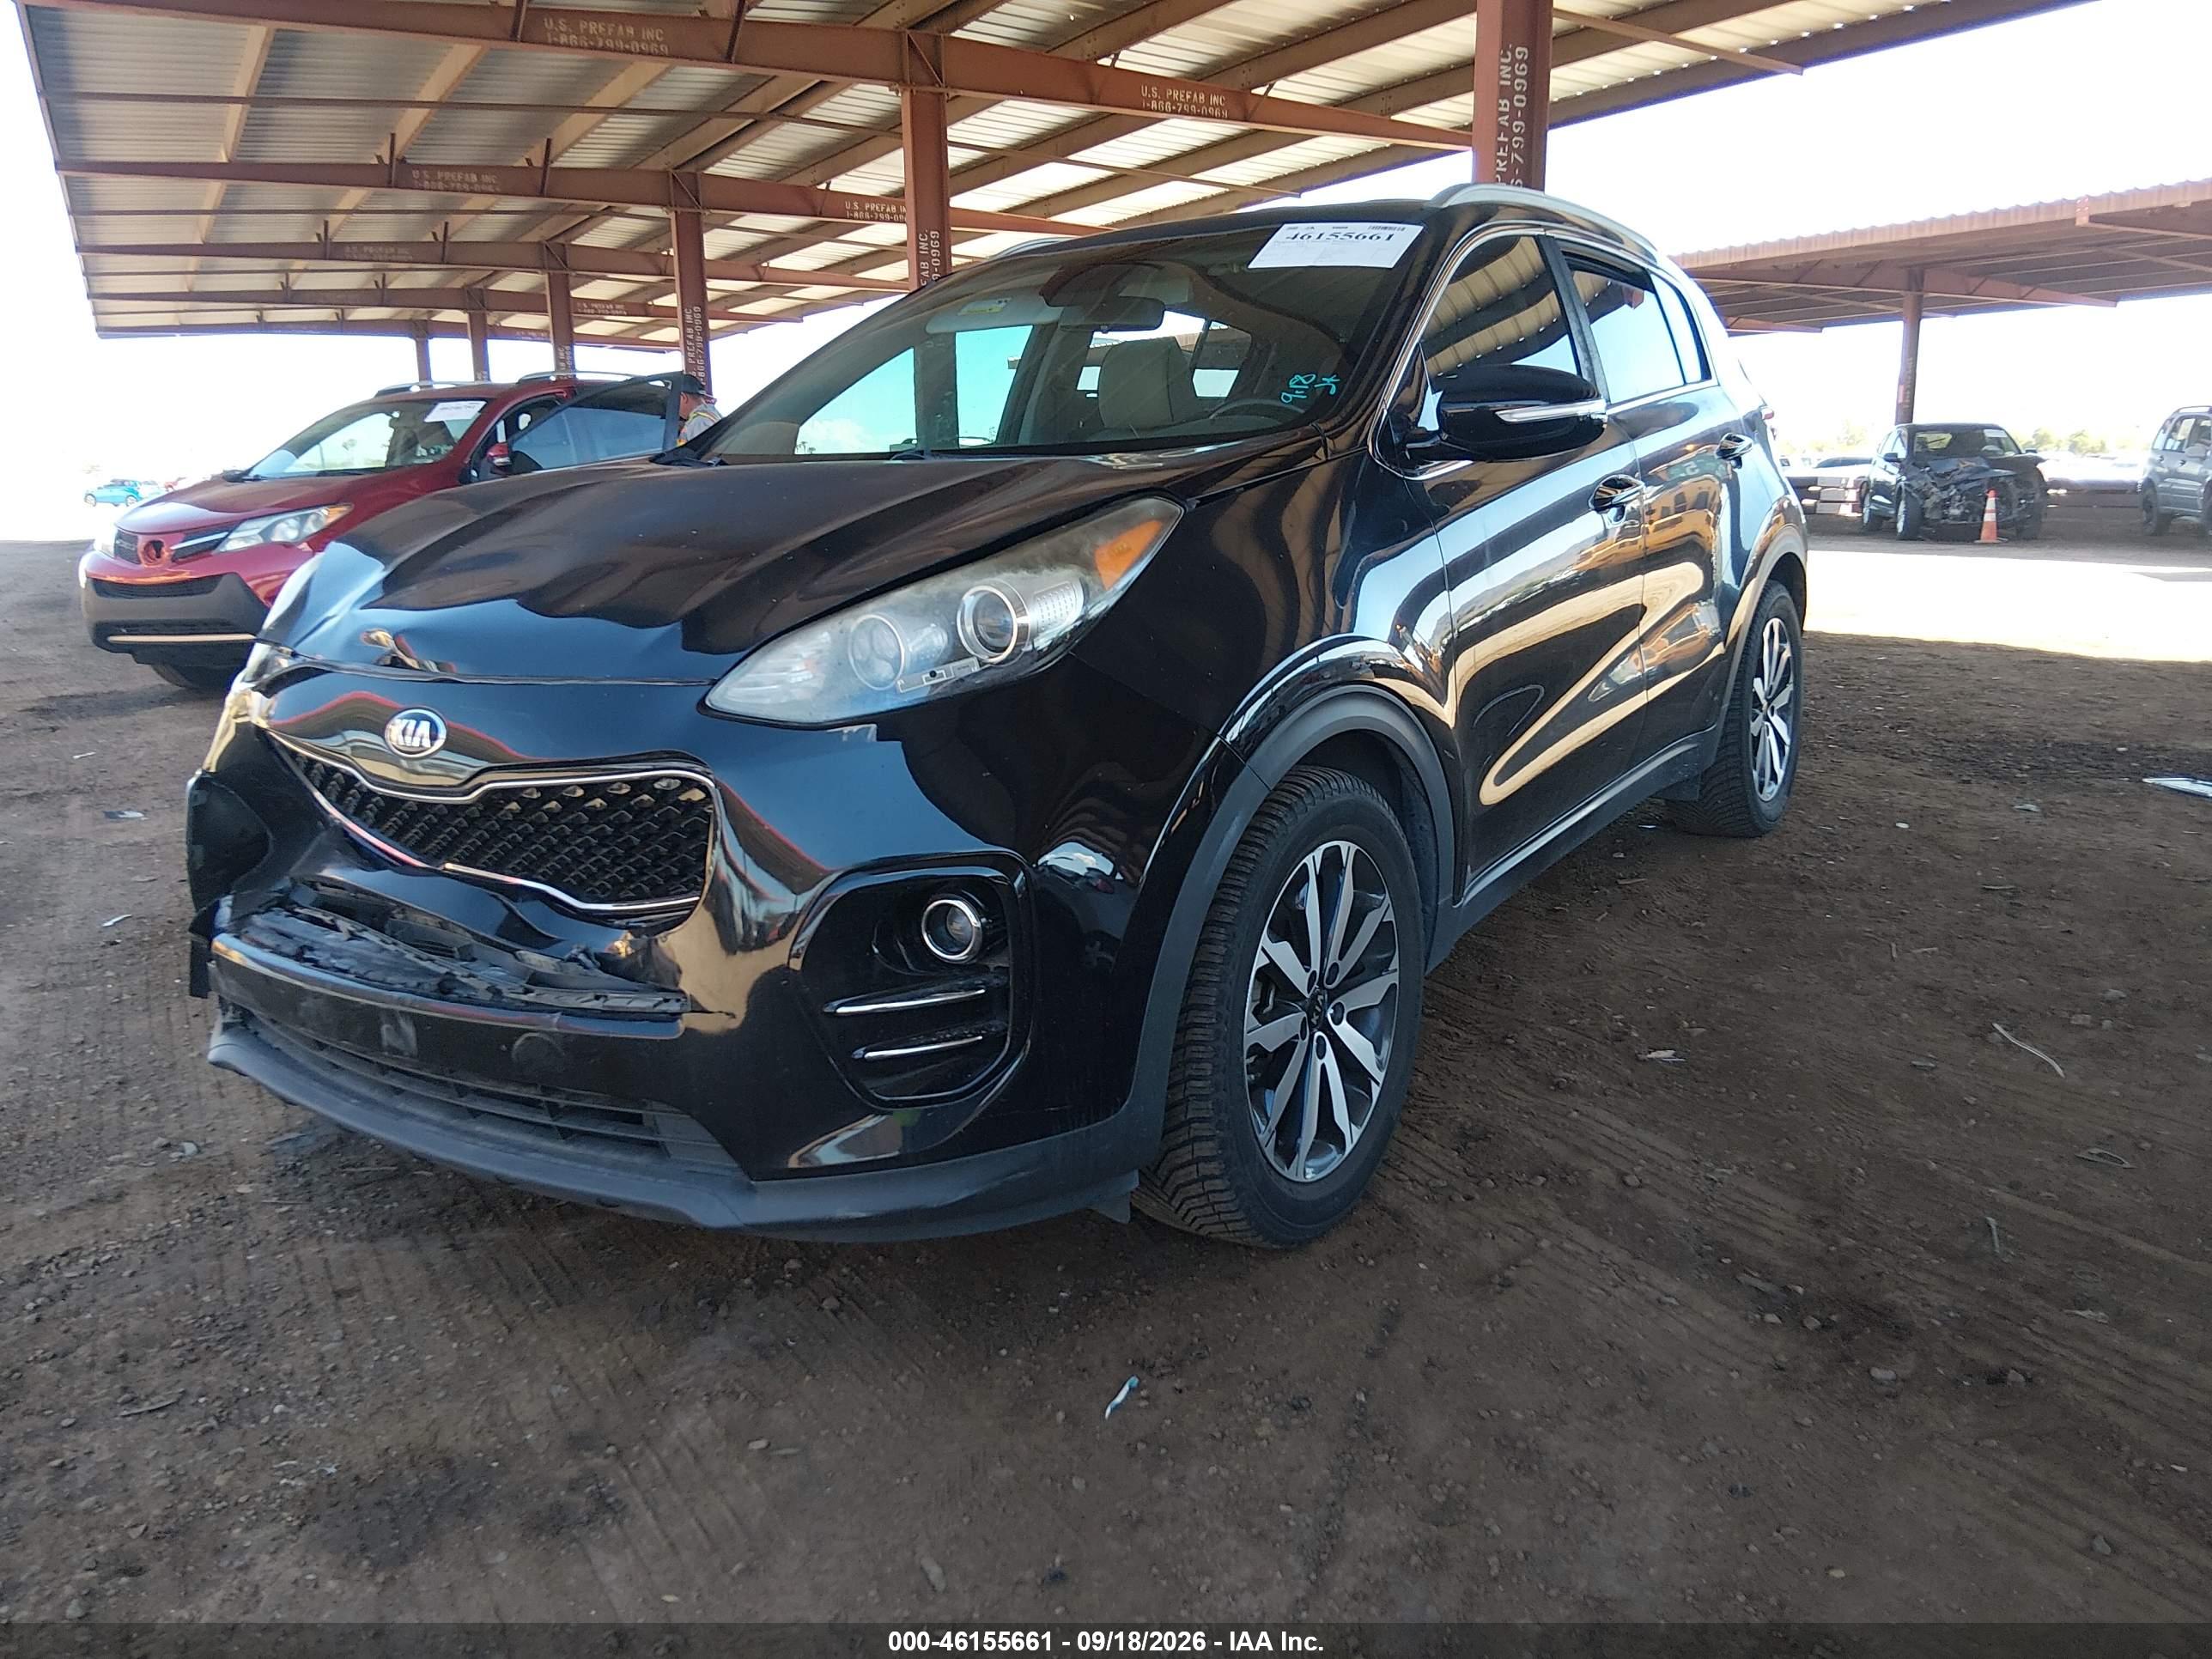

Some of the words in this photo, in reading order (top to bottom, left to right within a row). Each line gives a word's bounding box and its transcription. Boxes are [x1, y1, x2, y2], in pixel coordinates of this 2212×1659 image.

[641, 27, 664, 41] INC
[1140, 84, 1161, 100] U.S.
[1166, 88, 1206, 104] PREFAB
[1210, 93, 1226, 106] INC
[865, 203, 896, 214] PREFAB
[1285, 231, 1395, 241] 46155661
